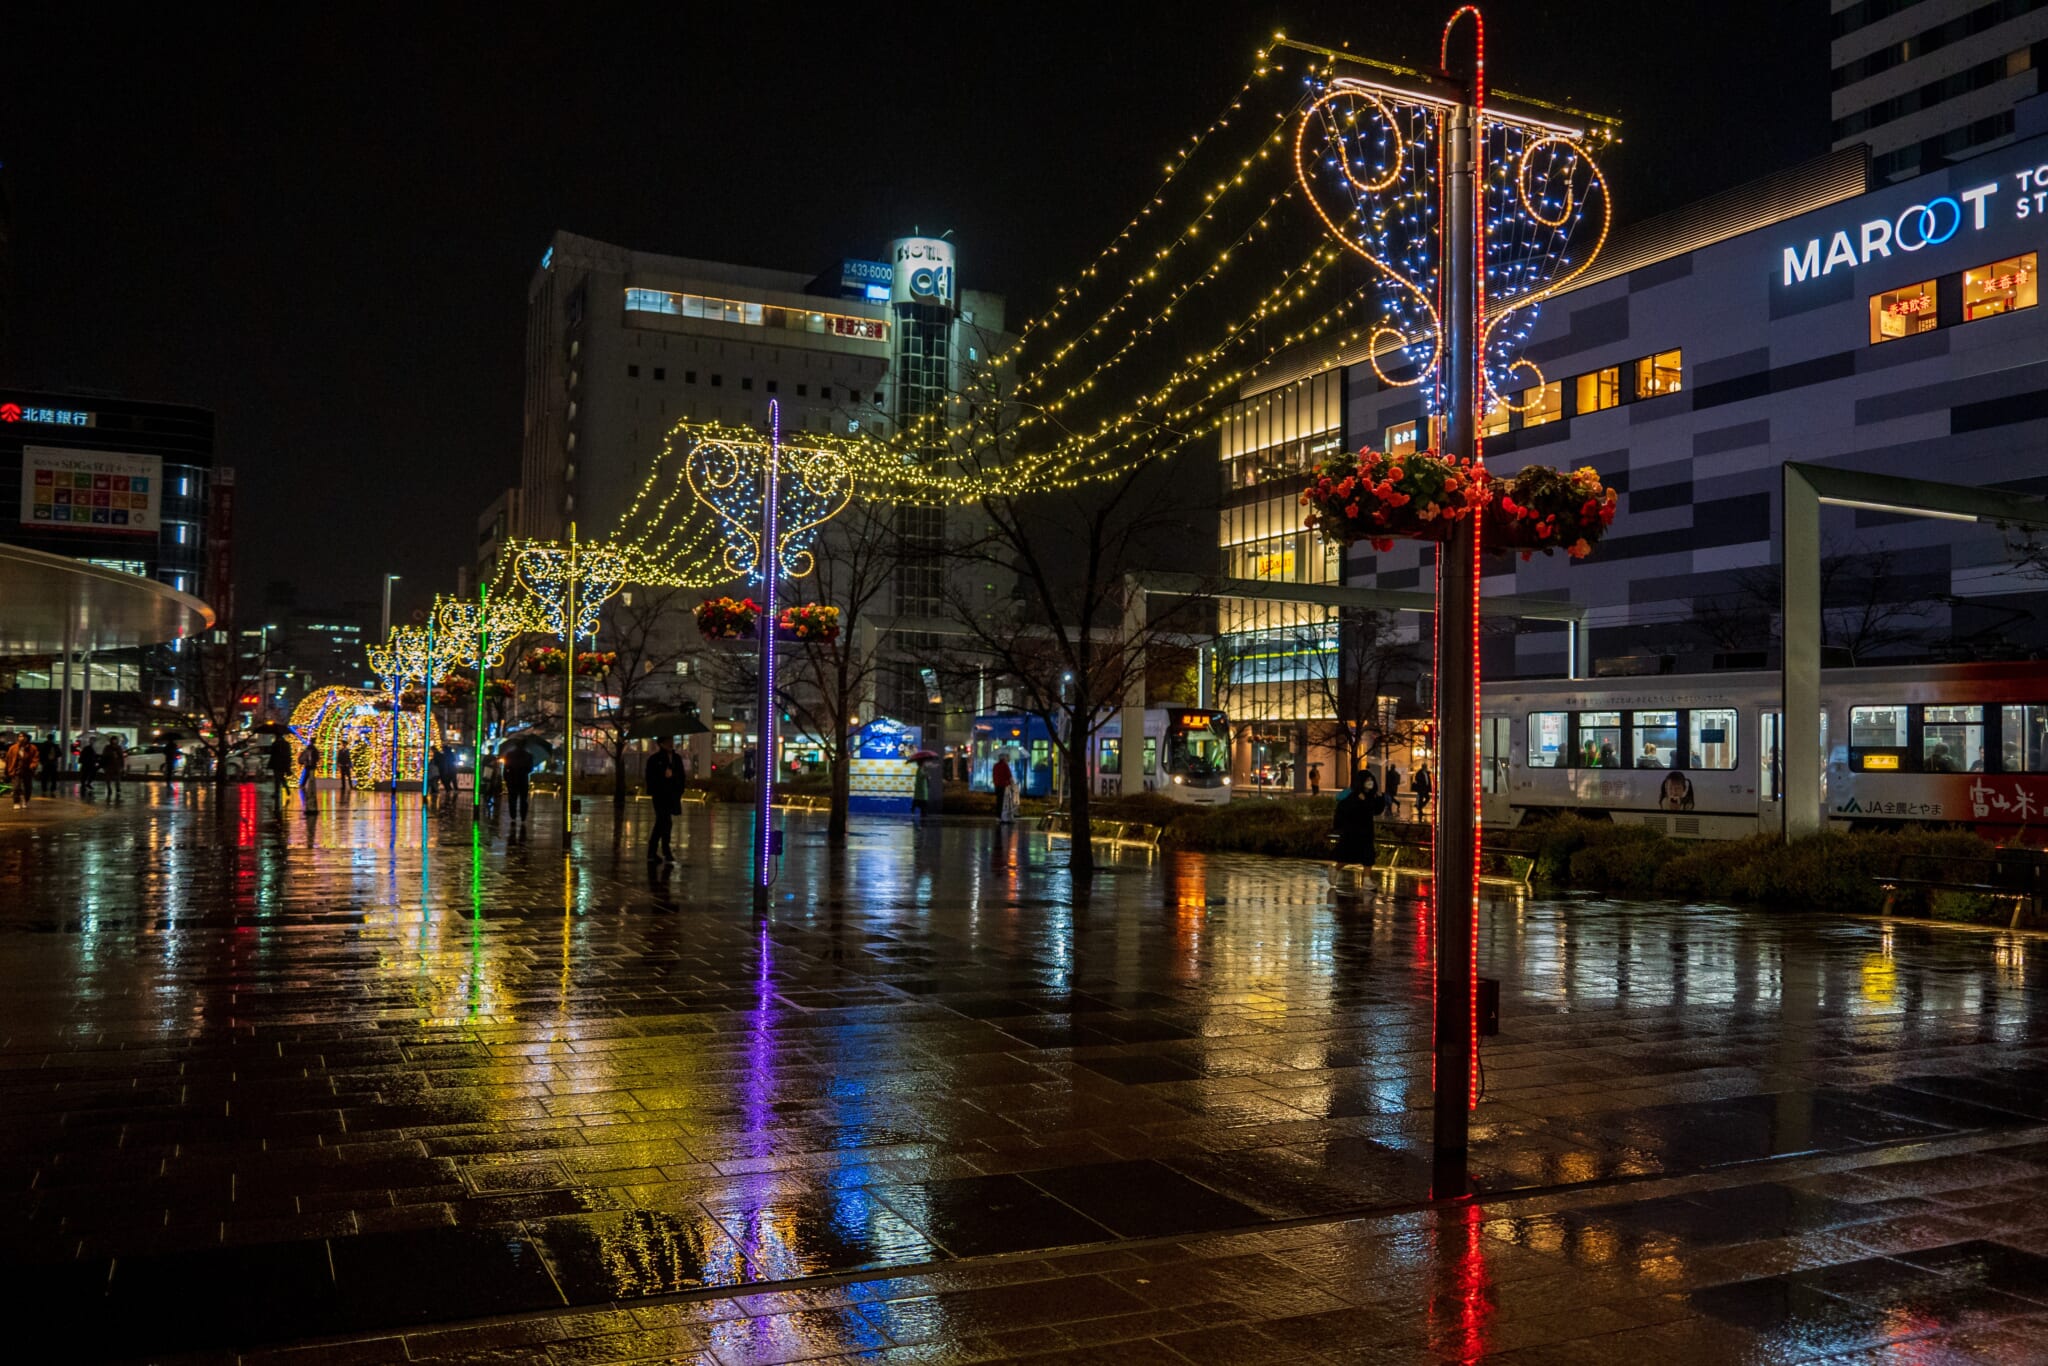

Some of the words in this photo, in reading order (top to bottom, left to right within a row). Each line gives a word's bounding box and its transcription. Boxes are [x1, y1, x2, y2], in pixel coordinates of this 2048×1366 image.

[1783, 183, 1998, 286] MAROOT
[850, 262, 892, 281] 433-6000
[22, 408, 89, 426] 北陸銀行
[1865, 801, 1943, 816] JA全農とやま
